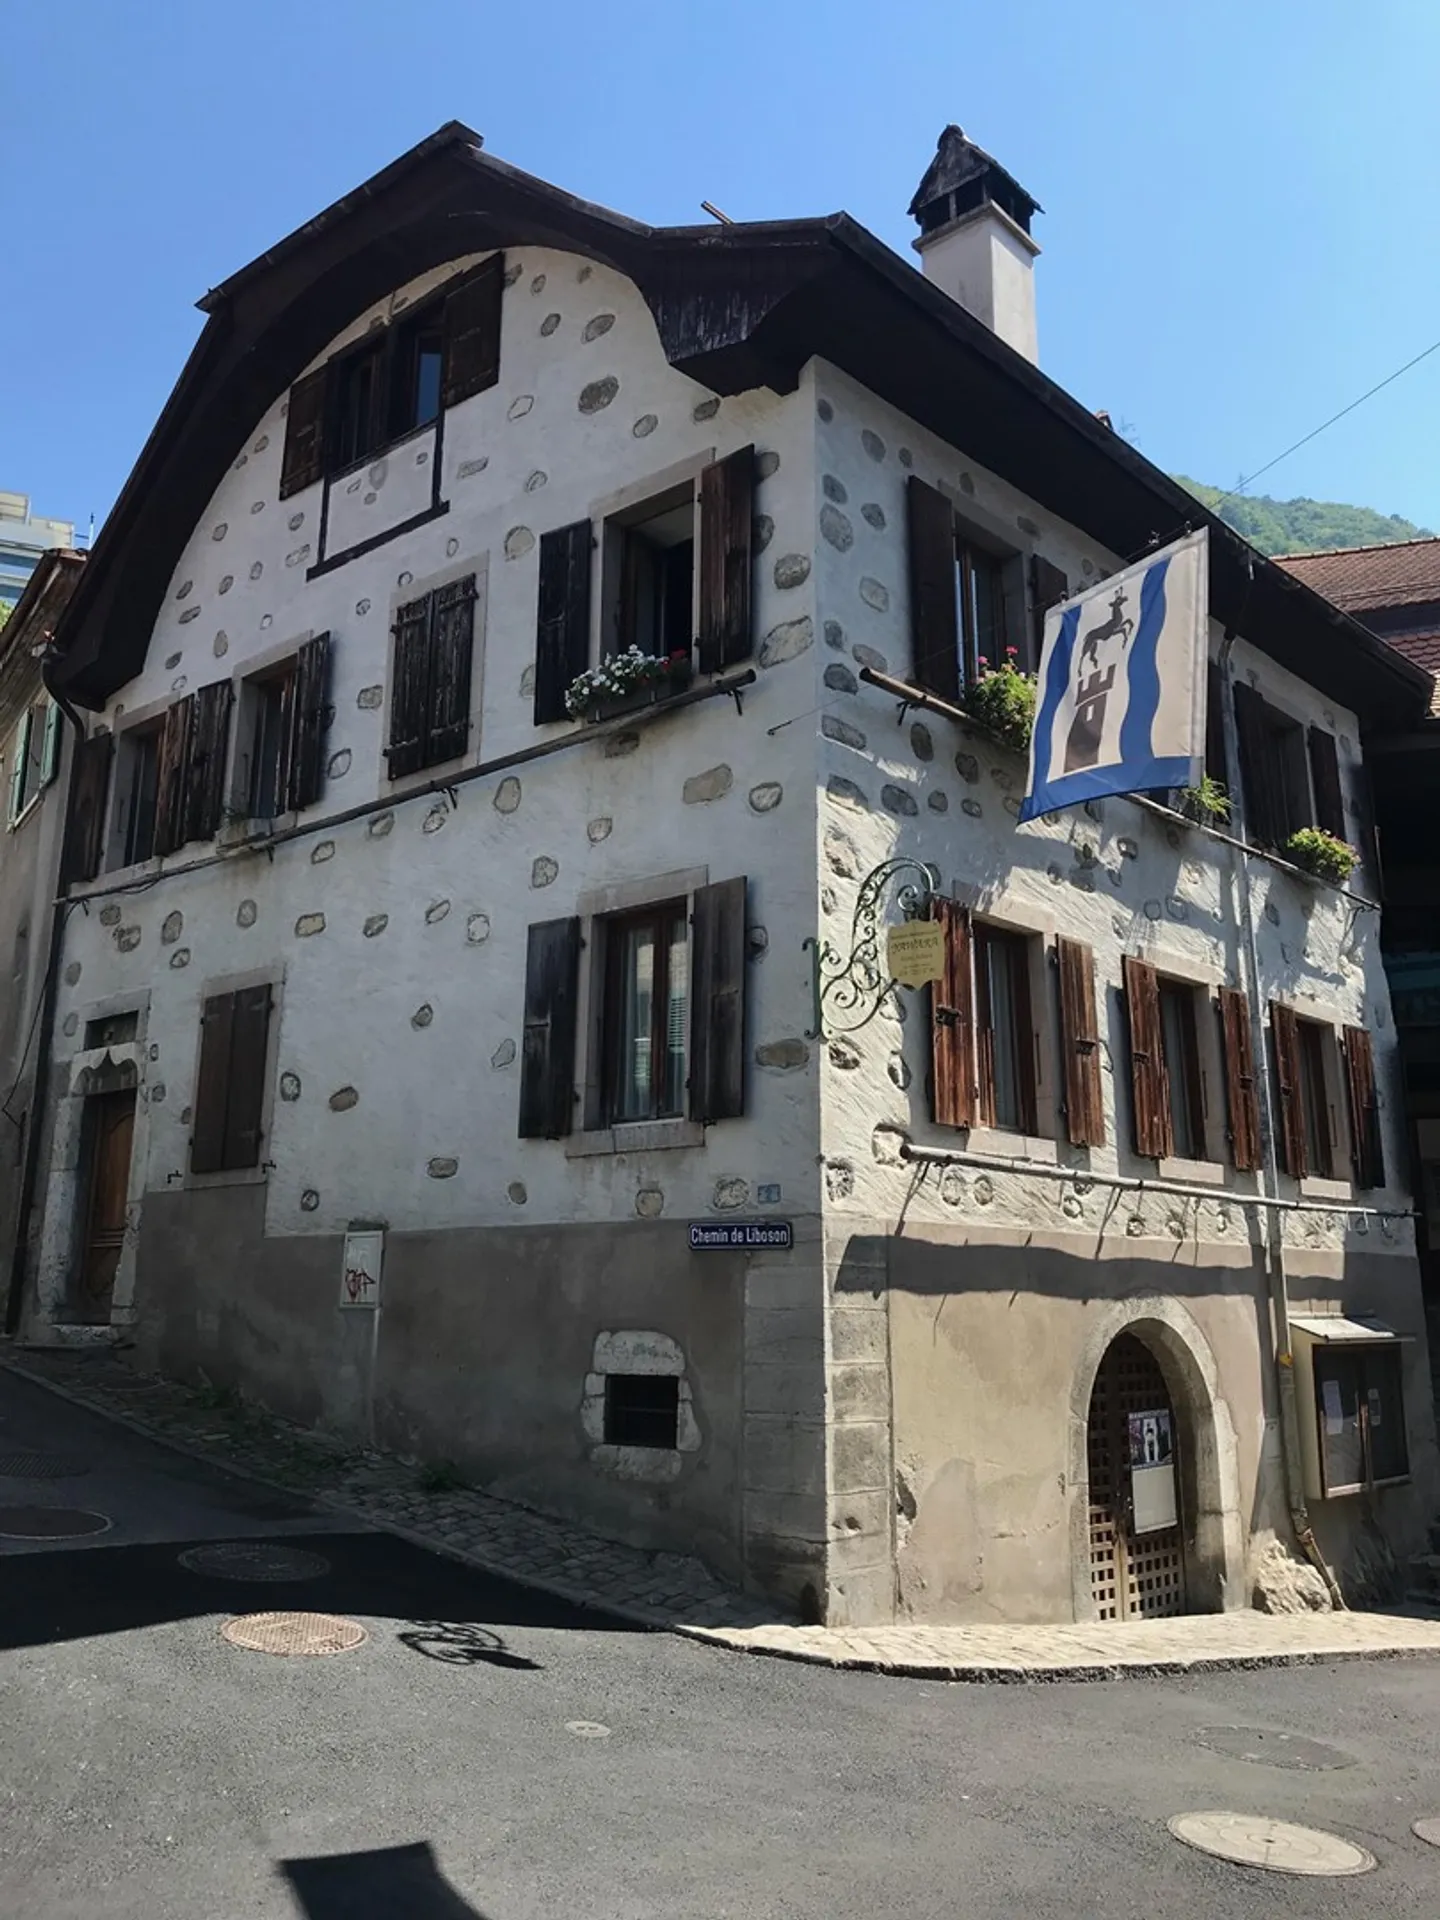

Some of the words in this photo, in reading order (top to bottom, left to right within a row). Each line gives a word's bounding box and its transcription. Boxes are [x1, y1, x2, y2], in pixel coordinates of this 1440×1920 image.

[691, 1227, 729, 1243] Chemin
[730, 1227, 744, 1242] de
[746, 1227, 787, 1242] Liboson
